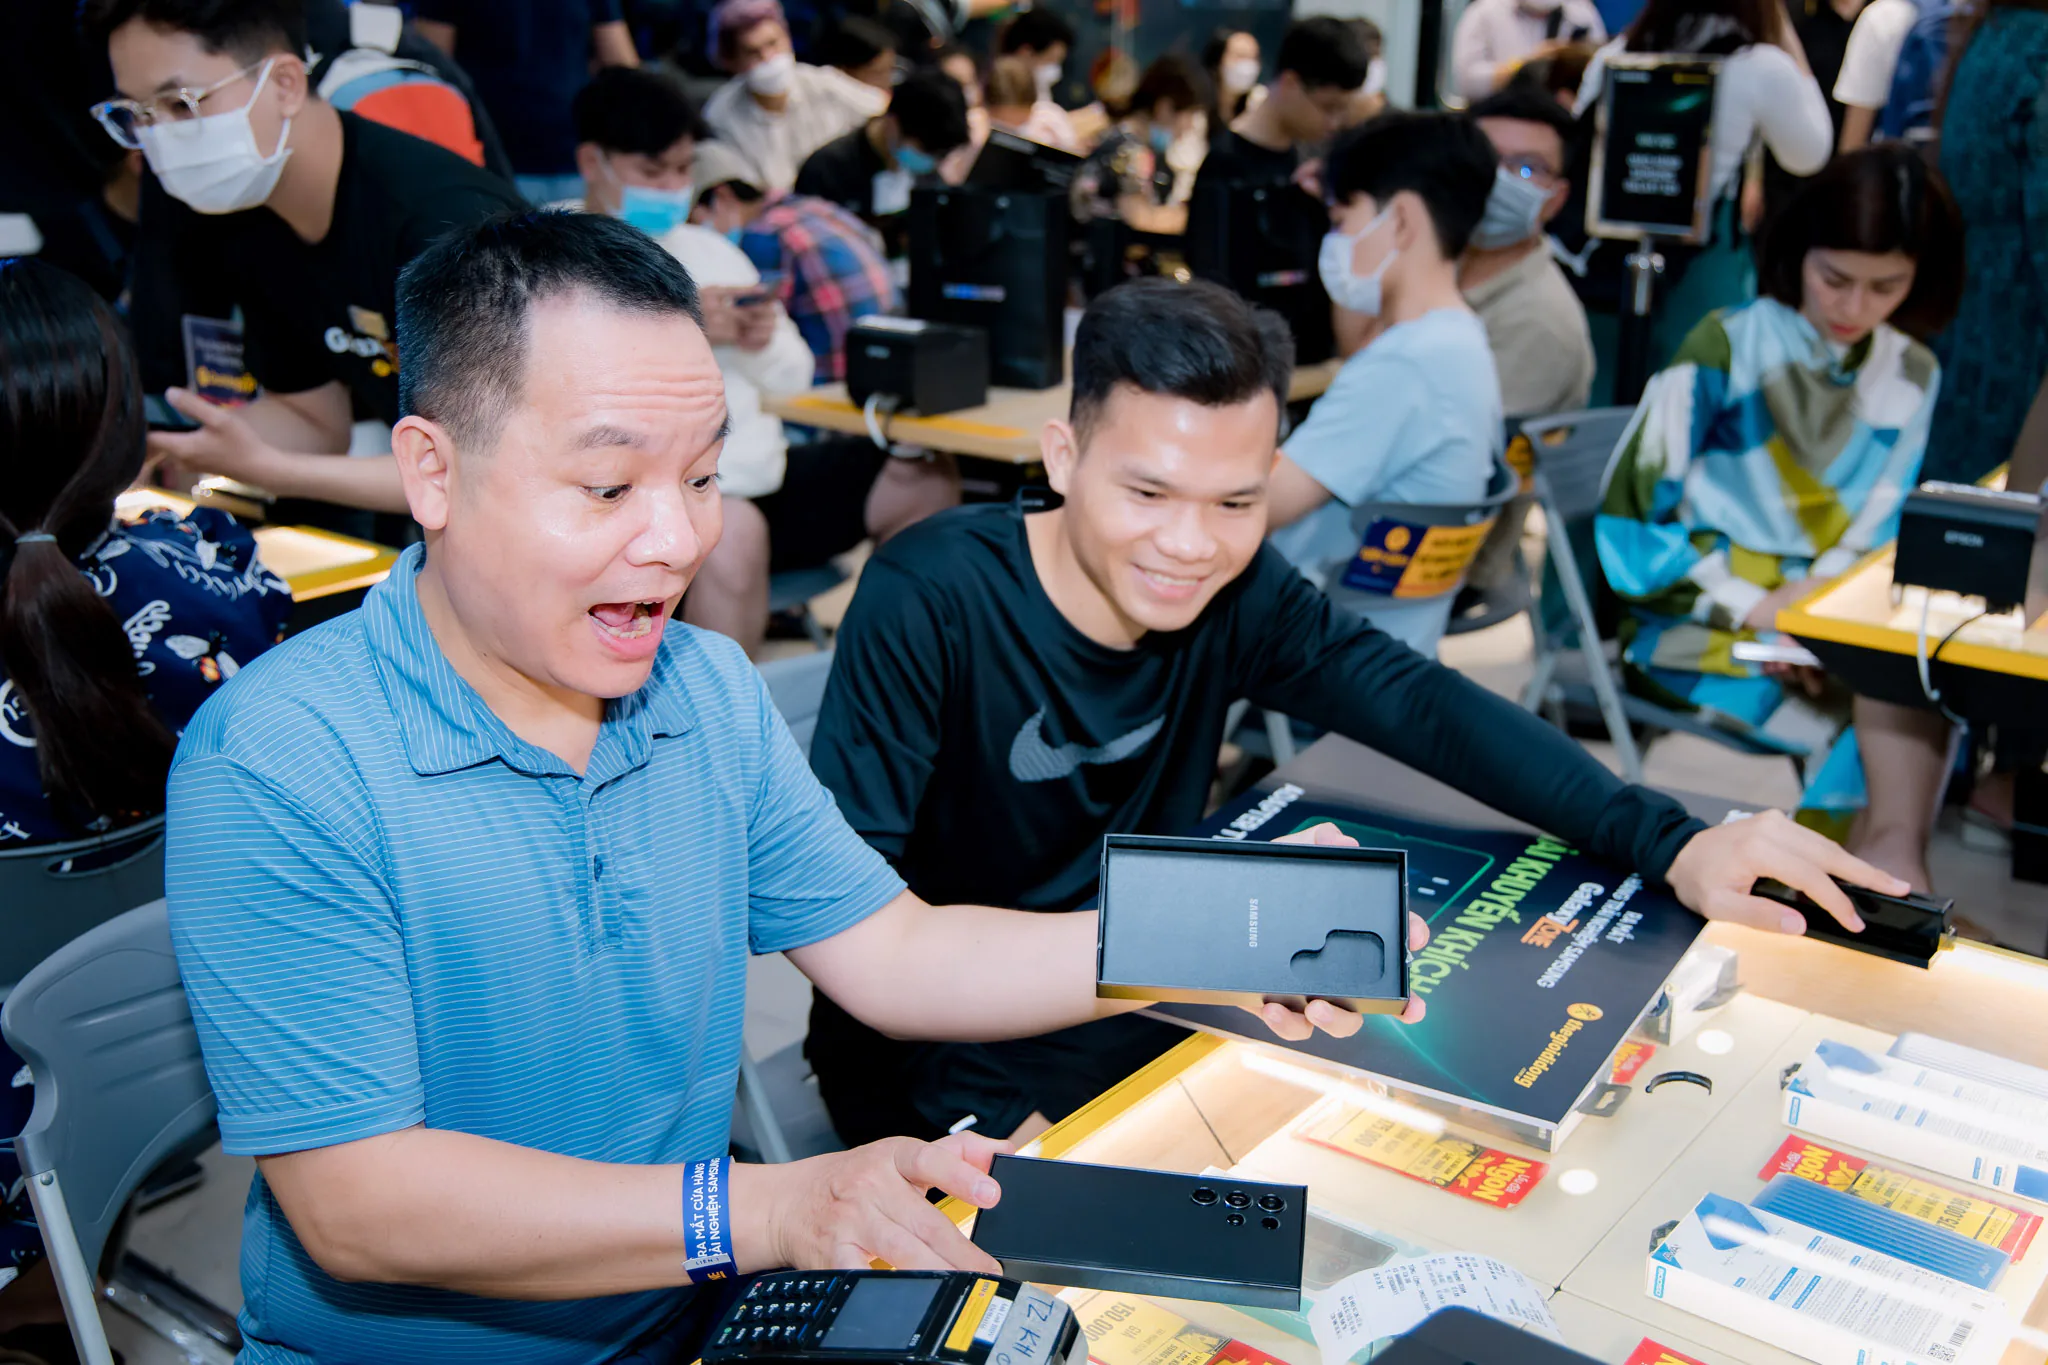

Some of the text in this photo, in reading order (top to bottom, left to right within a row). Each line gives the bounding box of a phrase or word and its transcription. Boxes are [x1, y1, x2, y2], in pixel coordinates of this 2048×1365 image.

[1524, 834, 1579, 862] ẢI
[1455, 857, 1554, 931] KHUYẾN
[1546, 882, 1605, 926] Galaxy
[1248, 898, 1259, 948] SAMSUNG
[1536, 941, 1587, 989] SAMSUNG
[1513, 1018, 1584, 1089] thegioididong
[691, 1163, 706, 1186] HÀNG
[708, 1157, 721, 1193] SAMSUNG
[705, 1195, 722, 1240] NGHIỆM
[696, 1241, 708, 1260] RA
